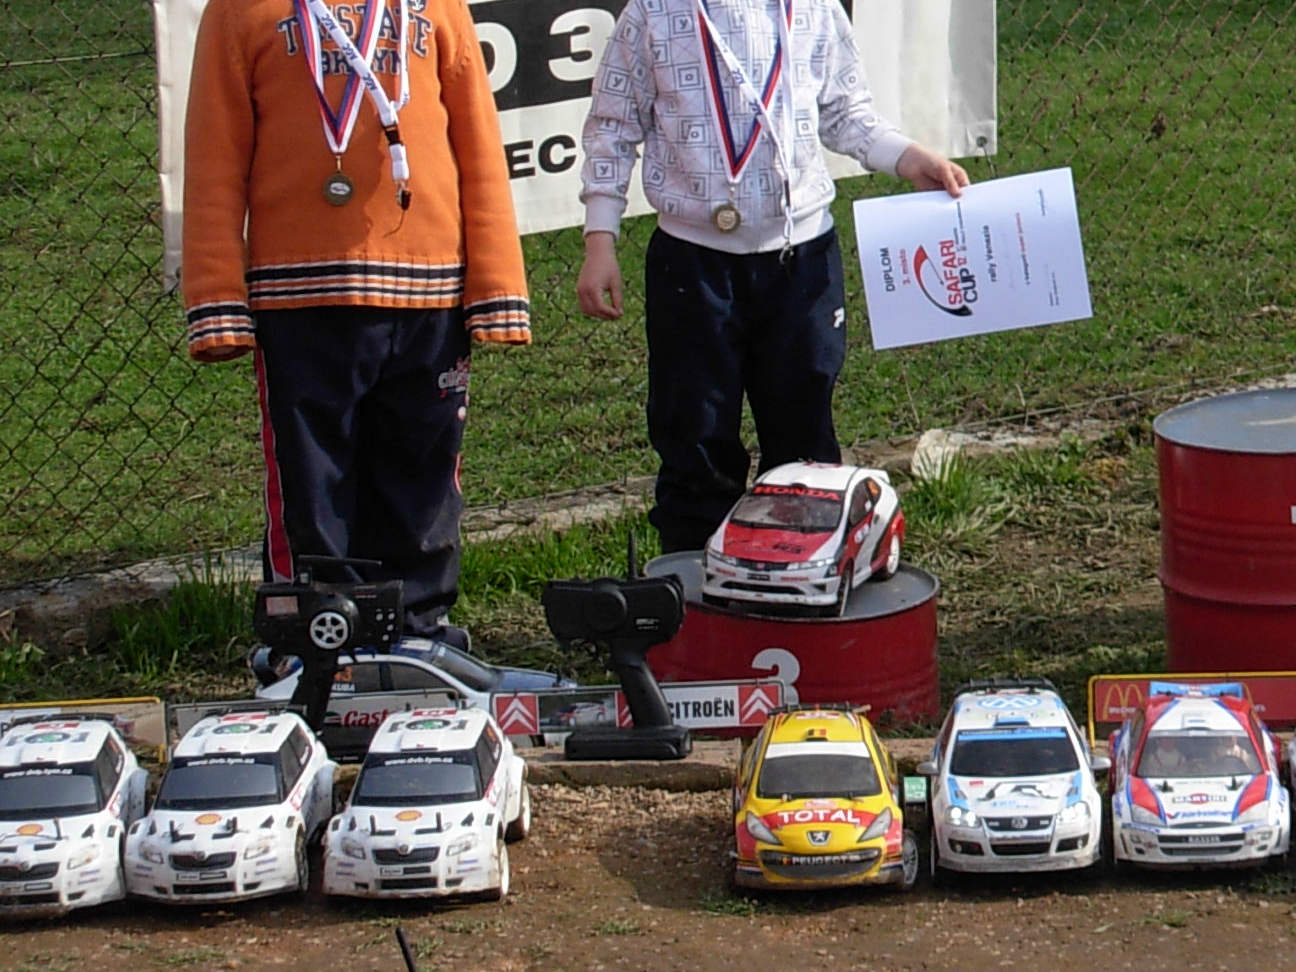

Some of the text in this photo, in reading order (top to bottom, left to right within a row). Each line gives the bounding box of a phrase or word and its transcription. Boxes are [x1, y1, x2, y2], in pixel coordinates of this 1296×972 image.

[879, 246, 896, 293] DIPLOM
[939, 239, 963, 306] SAFARI
[988, 262, 998, 283] rally
[960, 267, 979, 304] CUP
[753, 485, 842, 501] HONDA
[750, 647, 801, 706] 3
[1174, 794, 1225, 804] MARTINI
[777, 808, 861, 824] TOTAL
[791, 855, 848, 866] PEUGEOT
